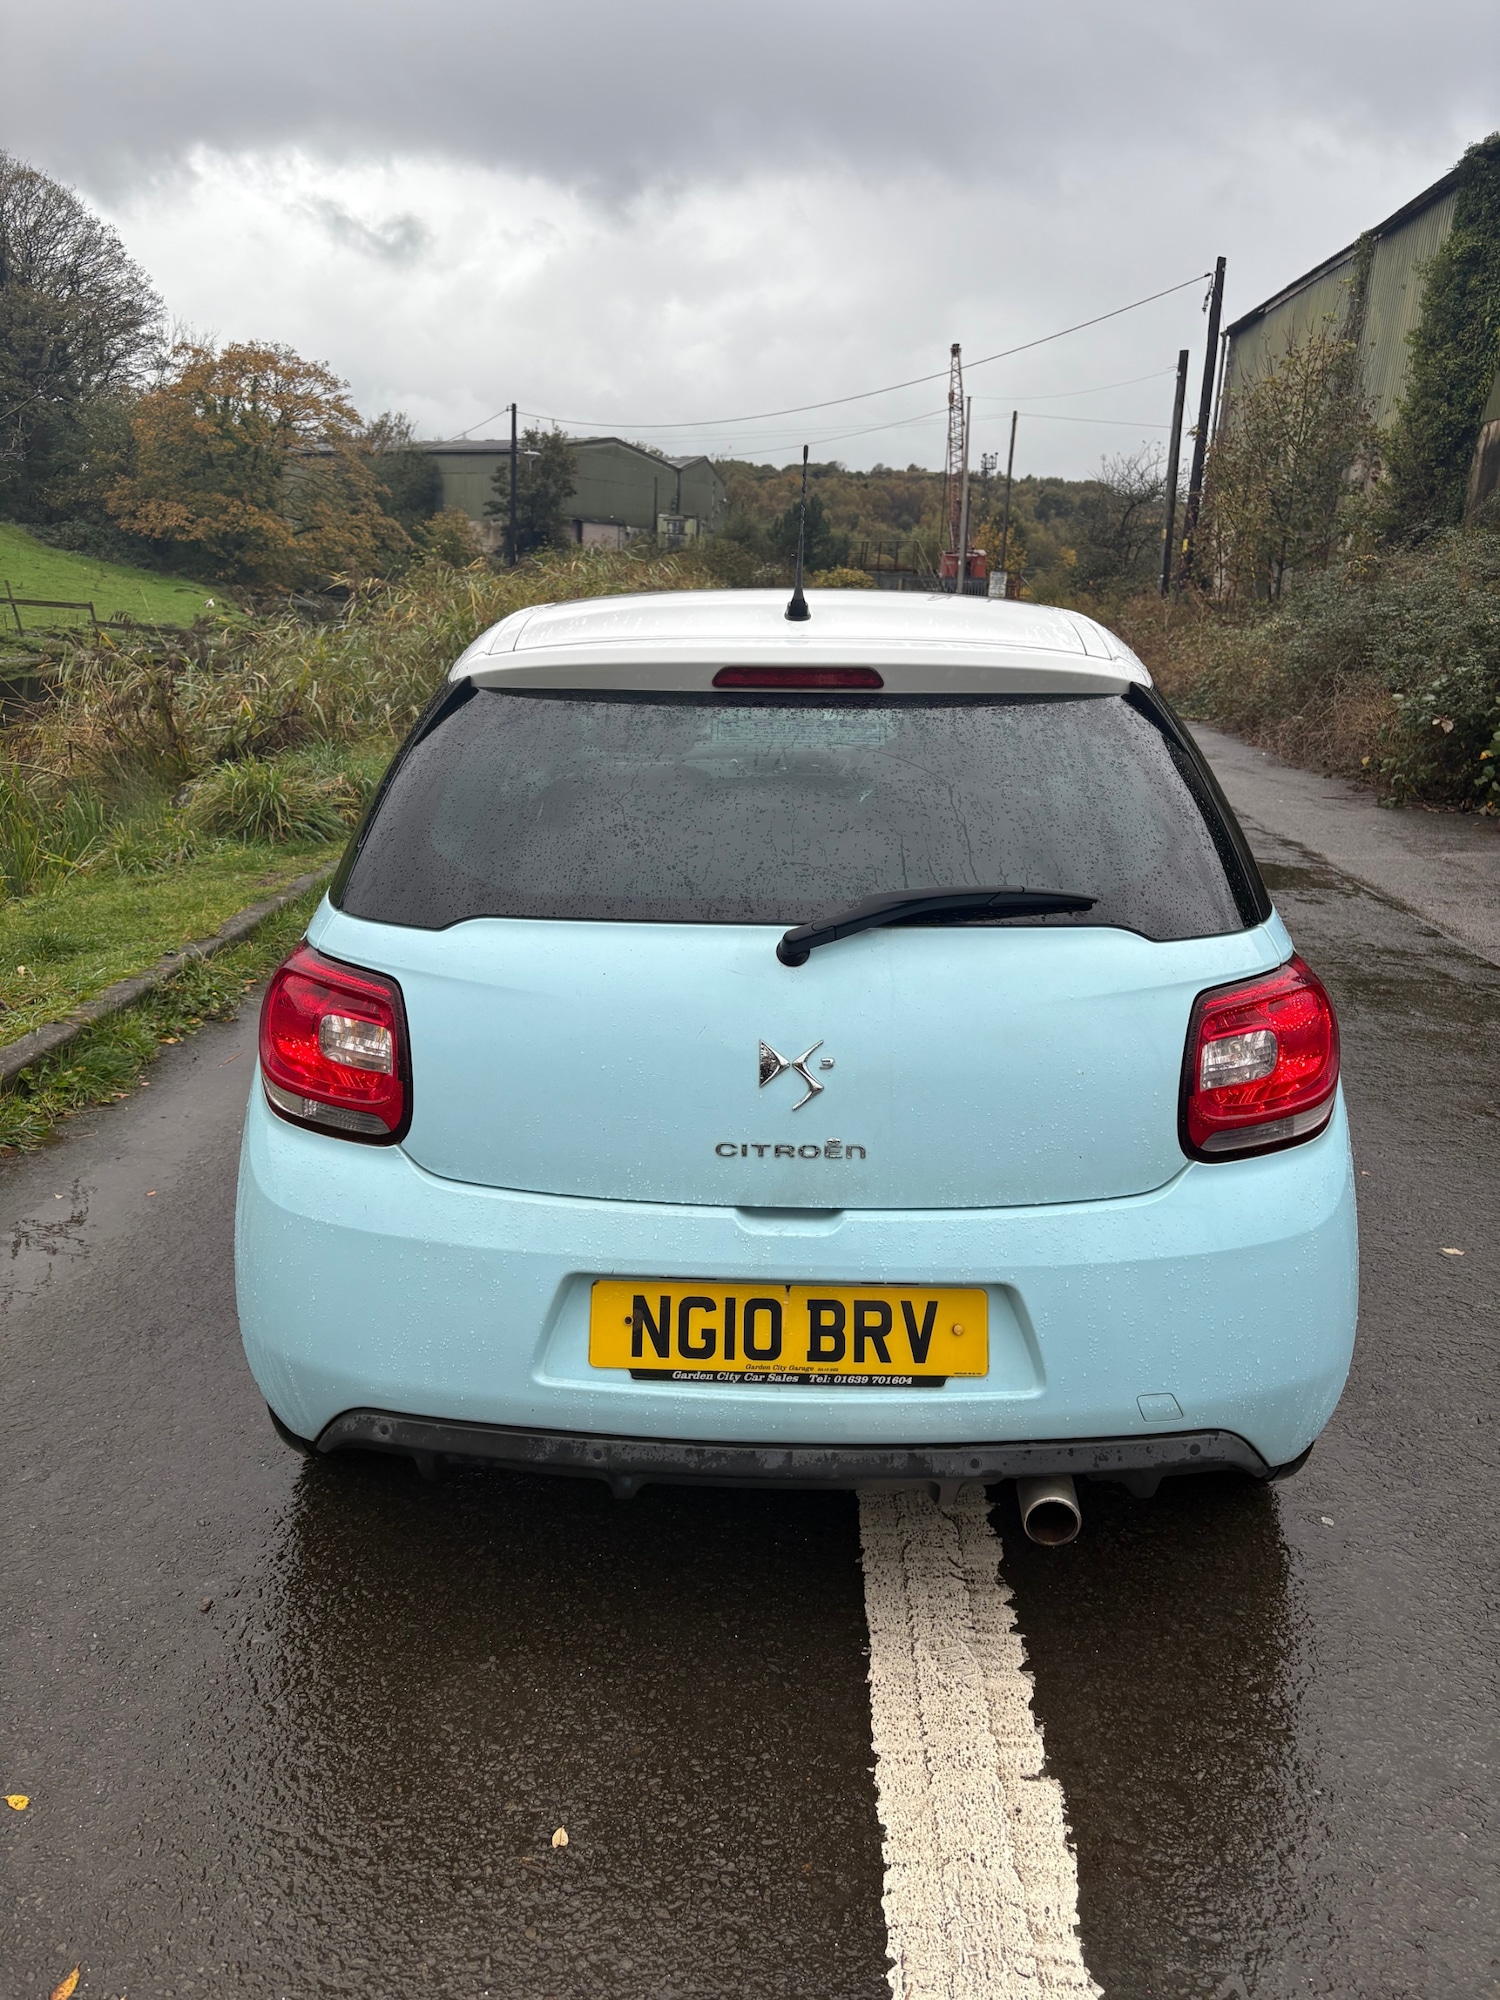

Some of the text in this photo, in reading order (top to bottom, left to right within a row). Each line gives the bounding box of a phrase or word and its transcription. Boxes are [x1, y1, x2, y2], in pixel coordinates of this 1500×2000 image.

[630, 1295, 939, 1364] NG10 BRV
[773, 1364, 787, 1372] City
[789, 1365, 815, 1373] Garage
[672, 1371, 913, 1385] Garden City Car Sales Tel: 01639 701604
